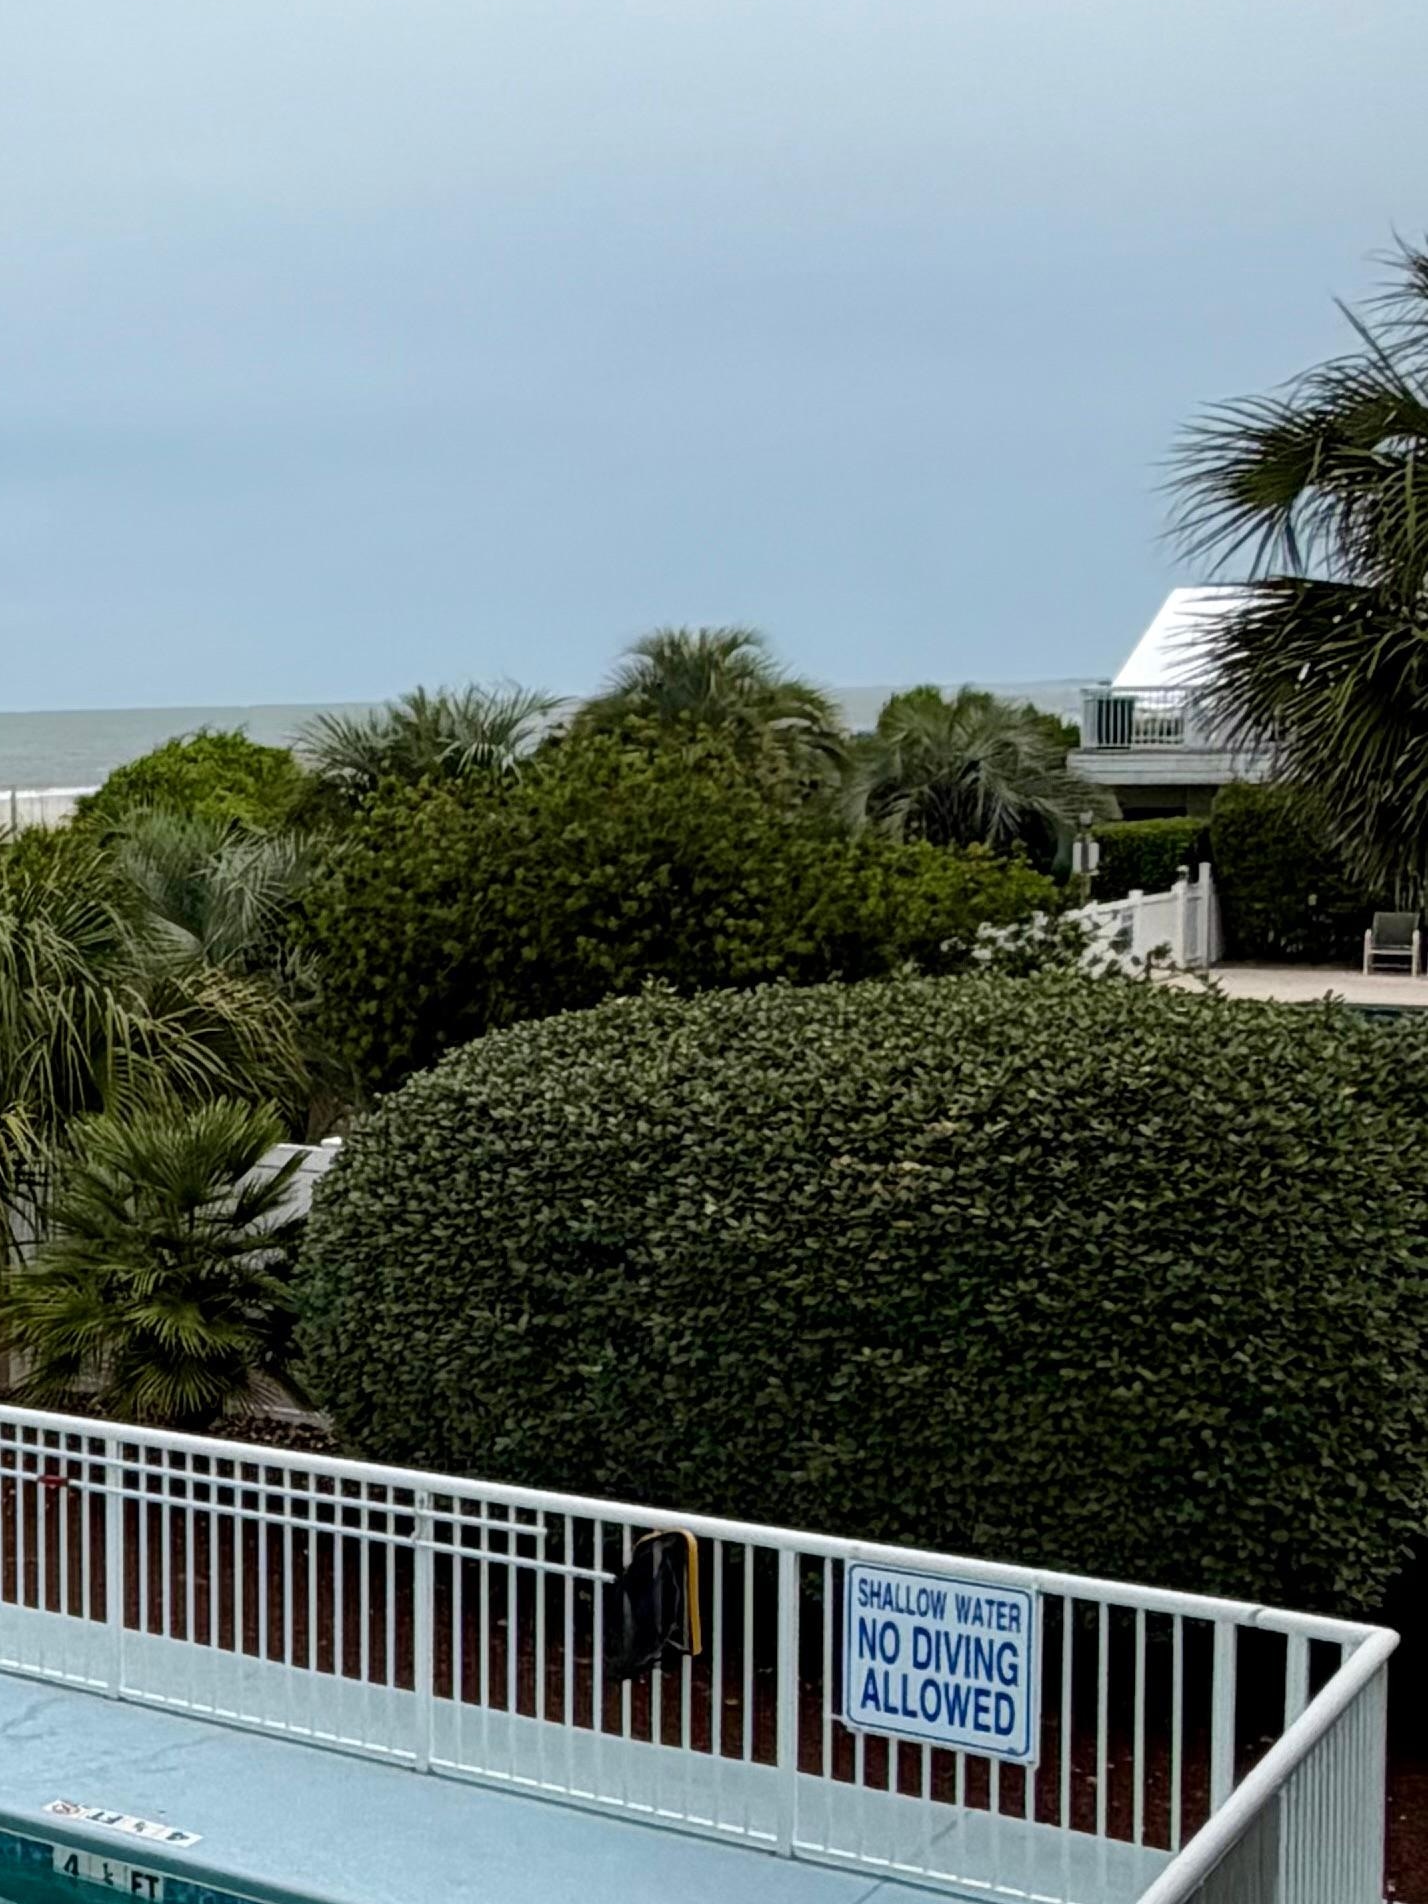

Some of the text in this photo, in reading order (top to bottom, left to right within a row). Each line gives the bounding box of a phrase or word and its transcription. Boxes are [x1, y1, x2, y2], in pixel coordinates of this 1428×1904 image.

[857, 1577, 1022, 1634] SHALLOW WATER
[858, 1616, 1020, 1687] NO DIVING
[860, 1667, 1016, 1736] ALLOWED
[130, 1870, 160, 1898] FT
